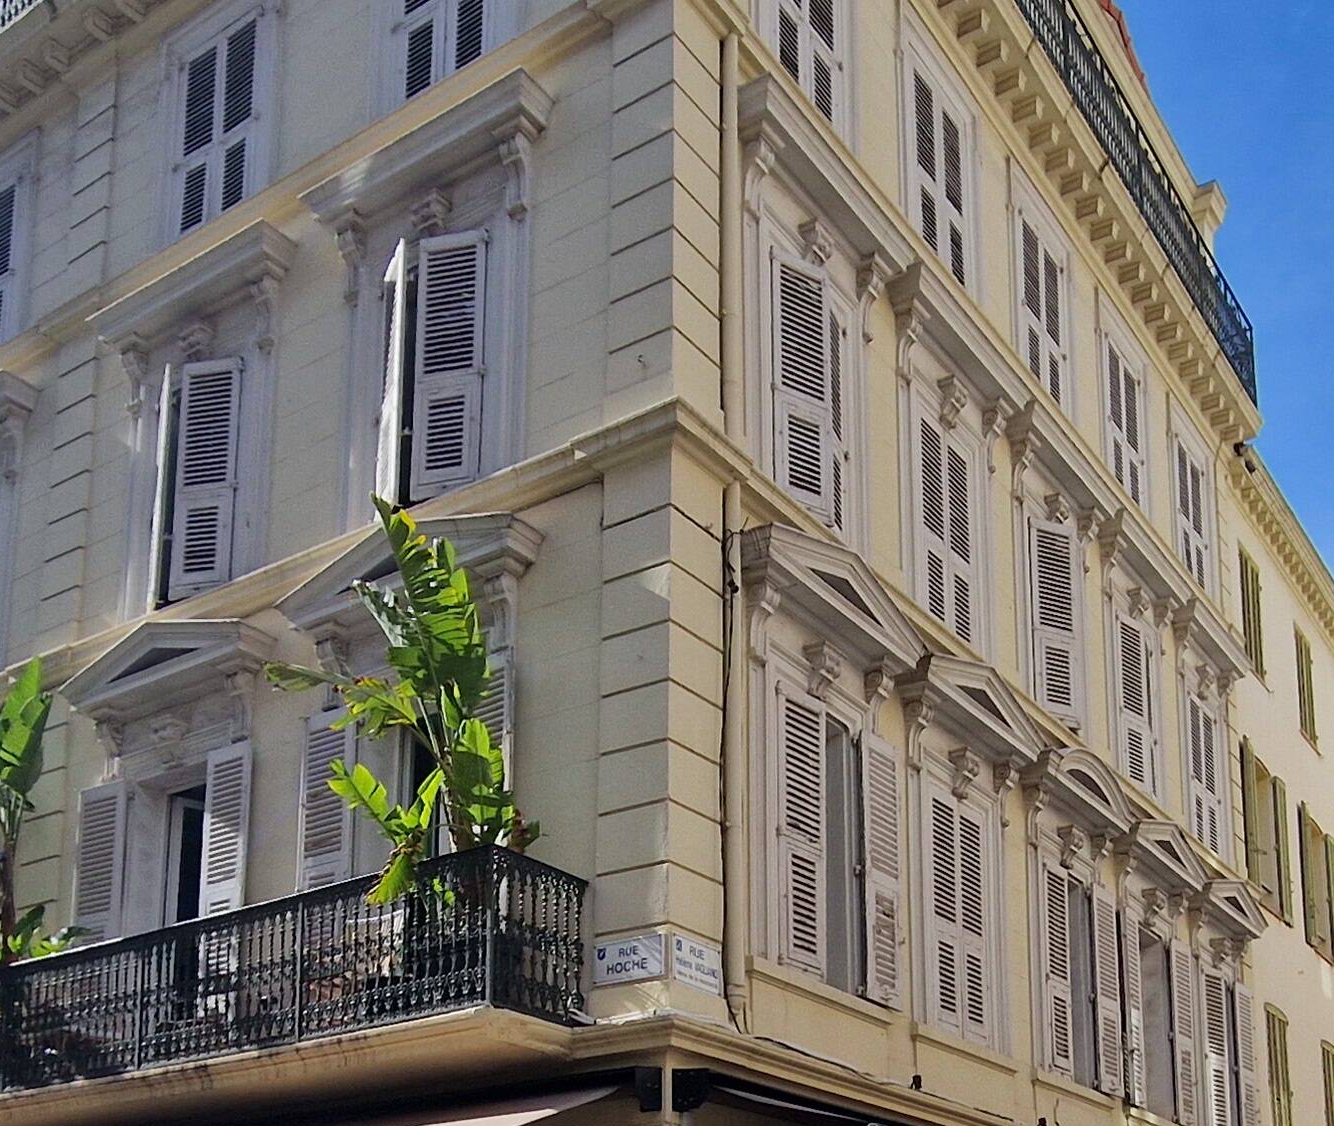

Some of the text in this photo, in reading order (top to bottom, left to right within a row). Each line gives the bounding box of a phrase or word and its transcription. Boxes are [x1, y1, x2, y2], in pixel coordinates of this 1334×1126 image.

[618, 945, 639, 958] RUE
[689, 945, 706, 960] RUE
[606, 957, 648, 975] HOCHE
